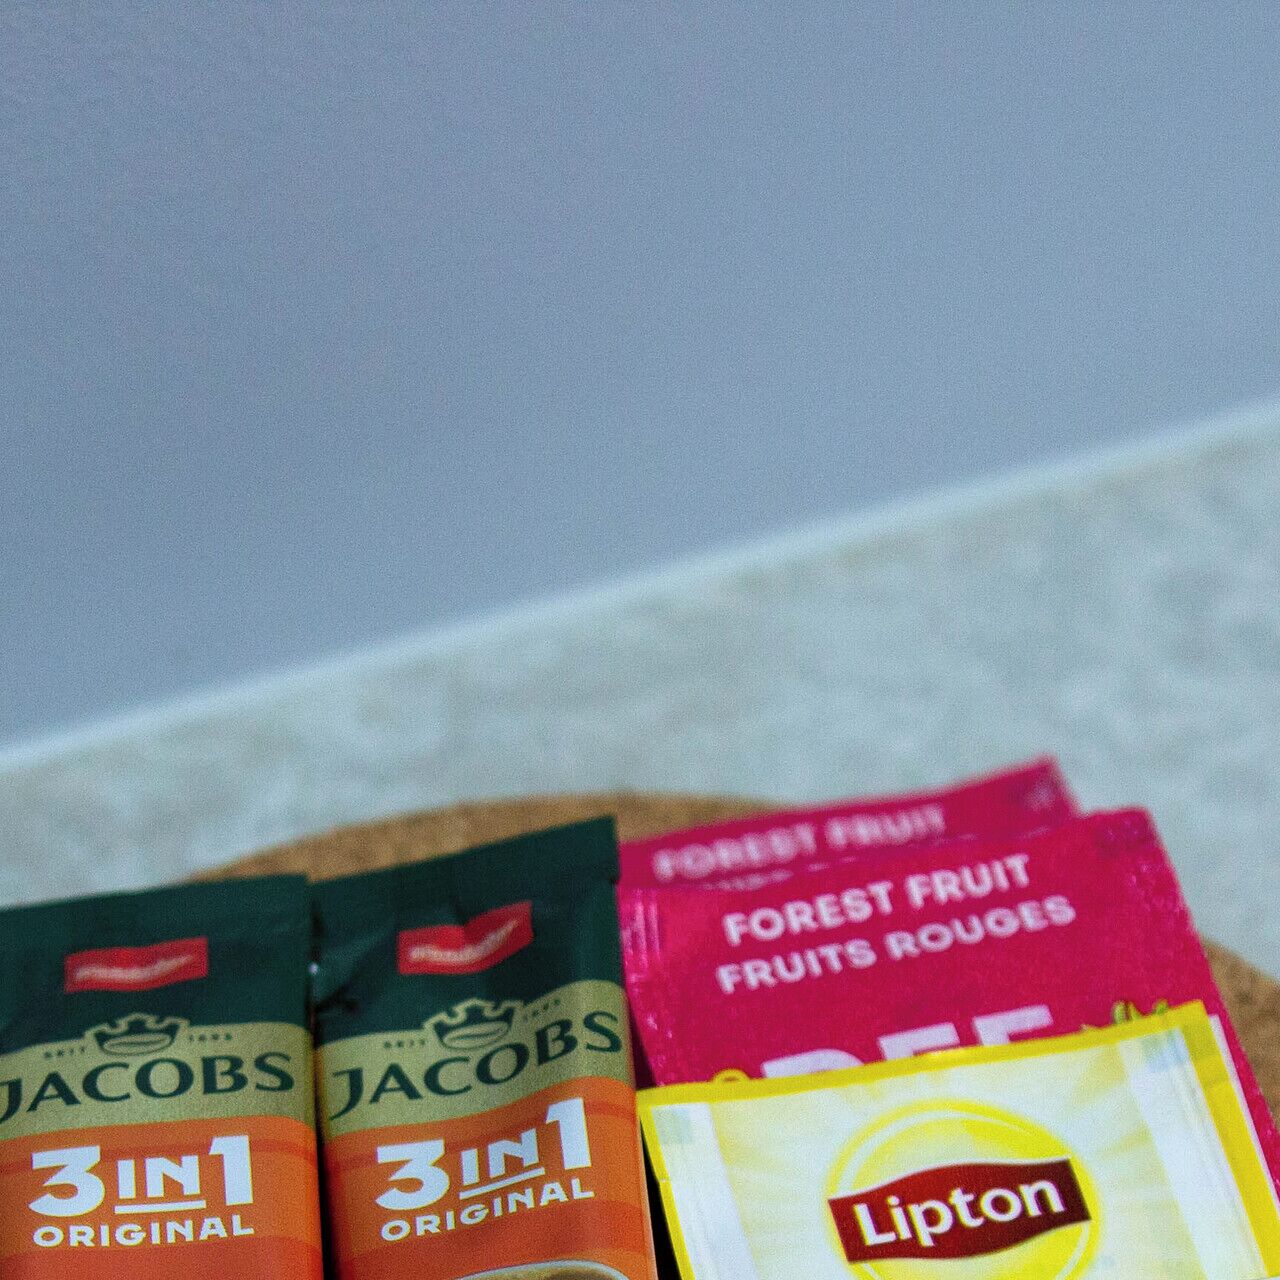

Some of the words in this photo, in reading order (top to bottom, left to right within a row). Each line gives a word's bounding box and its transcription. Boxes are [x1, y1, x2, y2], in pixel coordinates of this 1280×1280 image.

[653, 822, 815, 881] FOREST
[825, 803, 945, 848] FRUIT
[723, 880, 893, 947] FOREST
[906, 853, 1029, 909] FRUIT
[716, 938, 877, 994] FRUITS
[884, 895, 1076, 961] ROUGES
[330, 1011, 623, 1121] JACOBS
[33, 1214, 254, 1248] ORIGINAL
[381, 1177, 595, 1242] ORIGINAL
[853, 1180, 1066, 1247] Lipton
